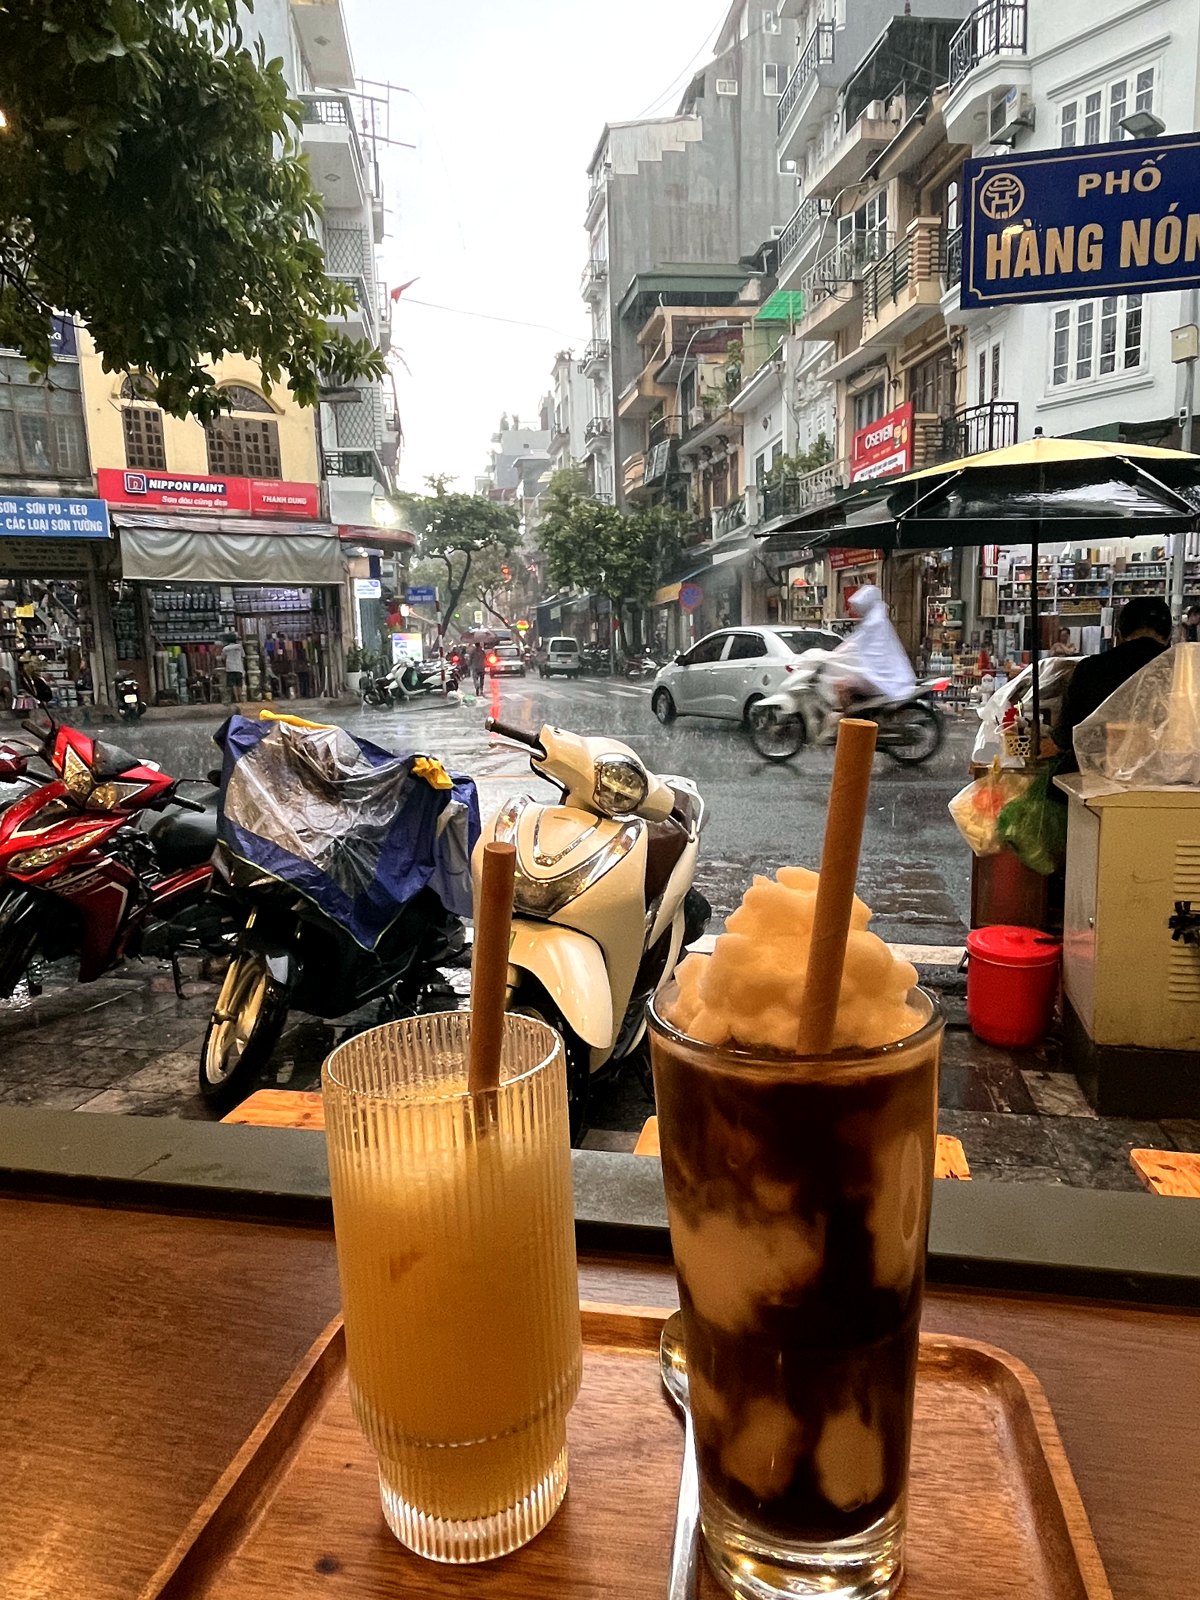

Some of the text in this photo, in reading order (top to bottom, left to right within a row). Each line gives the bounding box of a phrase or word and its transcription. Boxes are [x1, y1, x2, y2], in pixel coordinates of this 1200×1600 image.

[1078, 153, 1167, 198] PHỐ
[985, 218, 1104, 281] HÀNG
[149, 479, 224, 493] NIPPON PAINT
[262, 495, 287, 504] THANH
[26, 502, 46, 514] SƠN
[48, 503, 61, 515] PU
[69, 504, 88, 516] KEO
[6, 516, 26, 530] CÁC
[28, 518, 49, 533] LOẠI
[51, 519, 71, 531] SƠN
[72, 518, 103, 532] TƯỜNG
